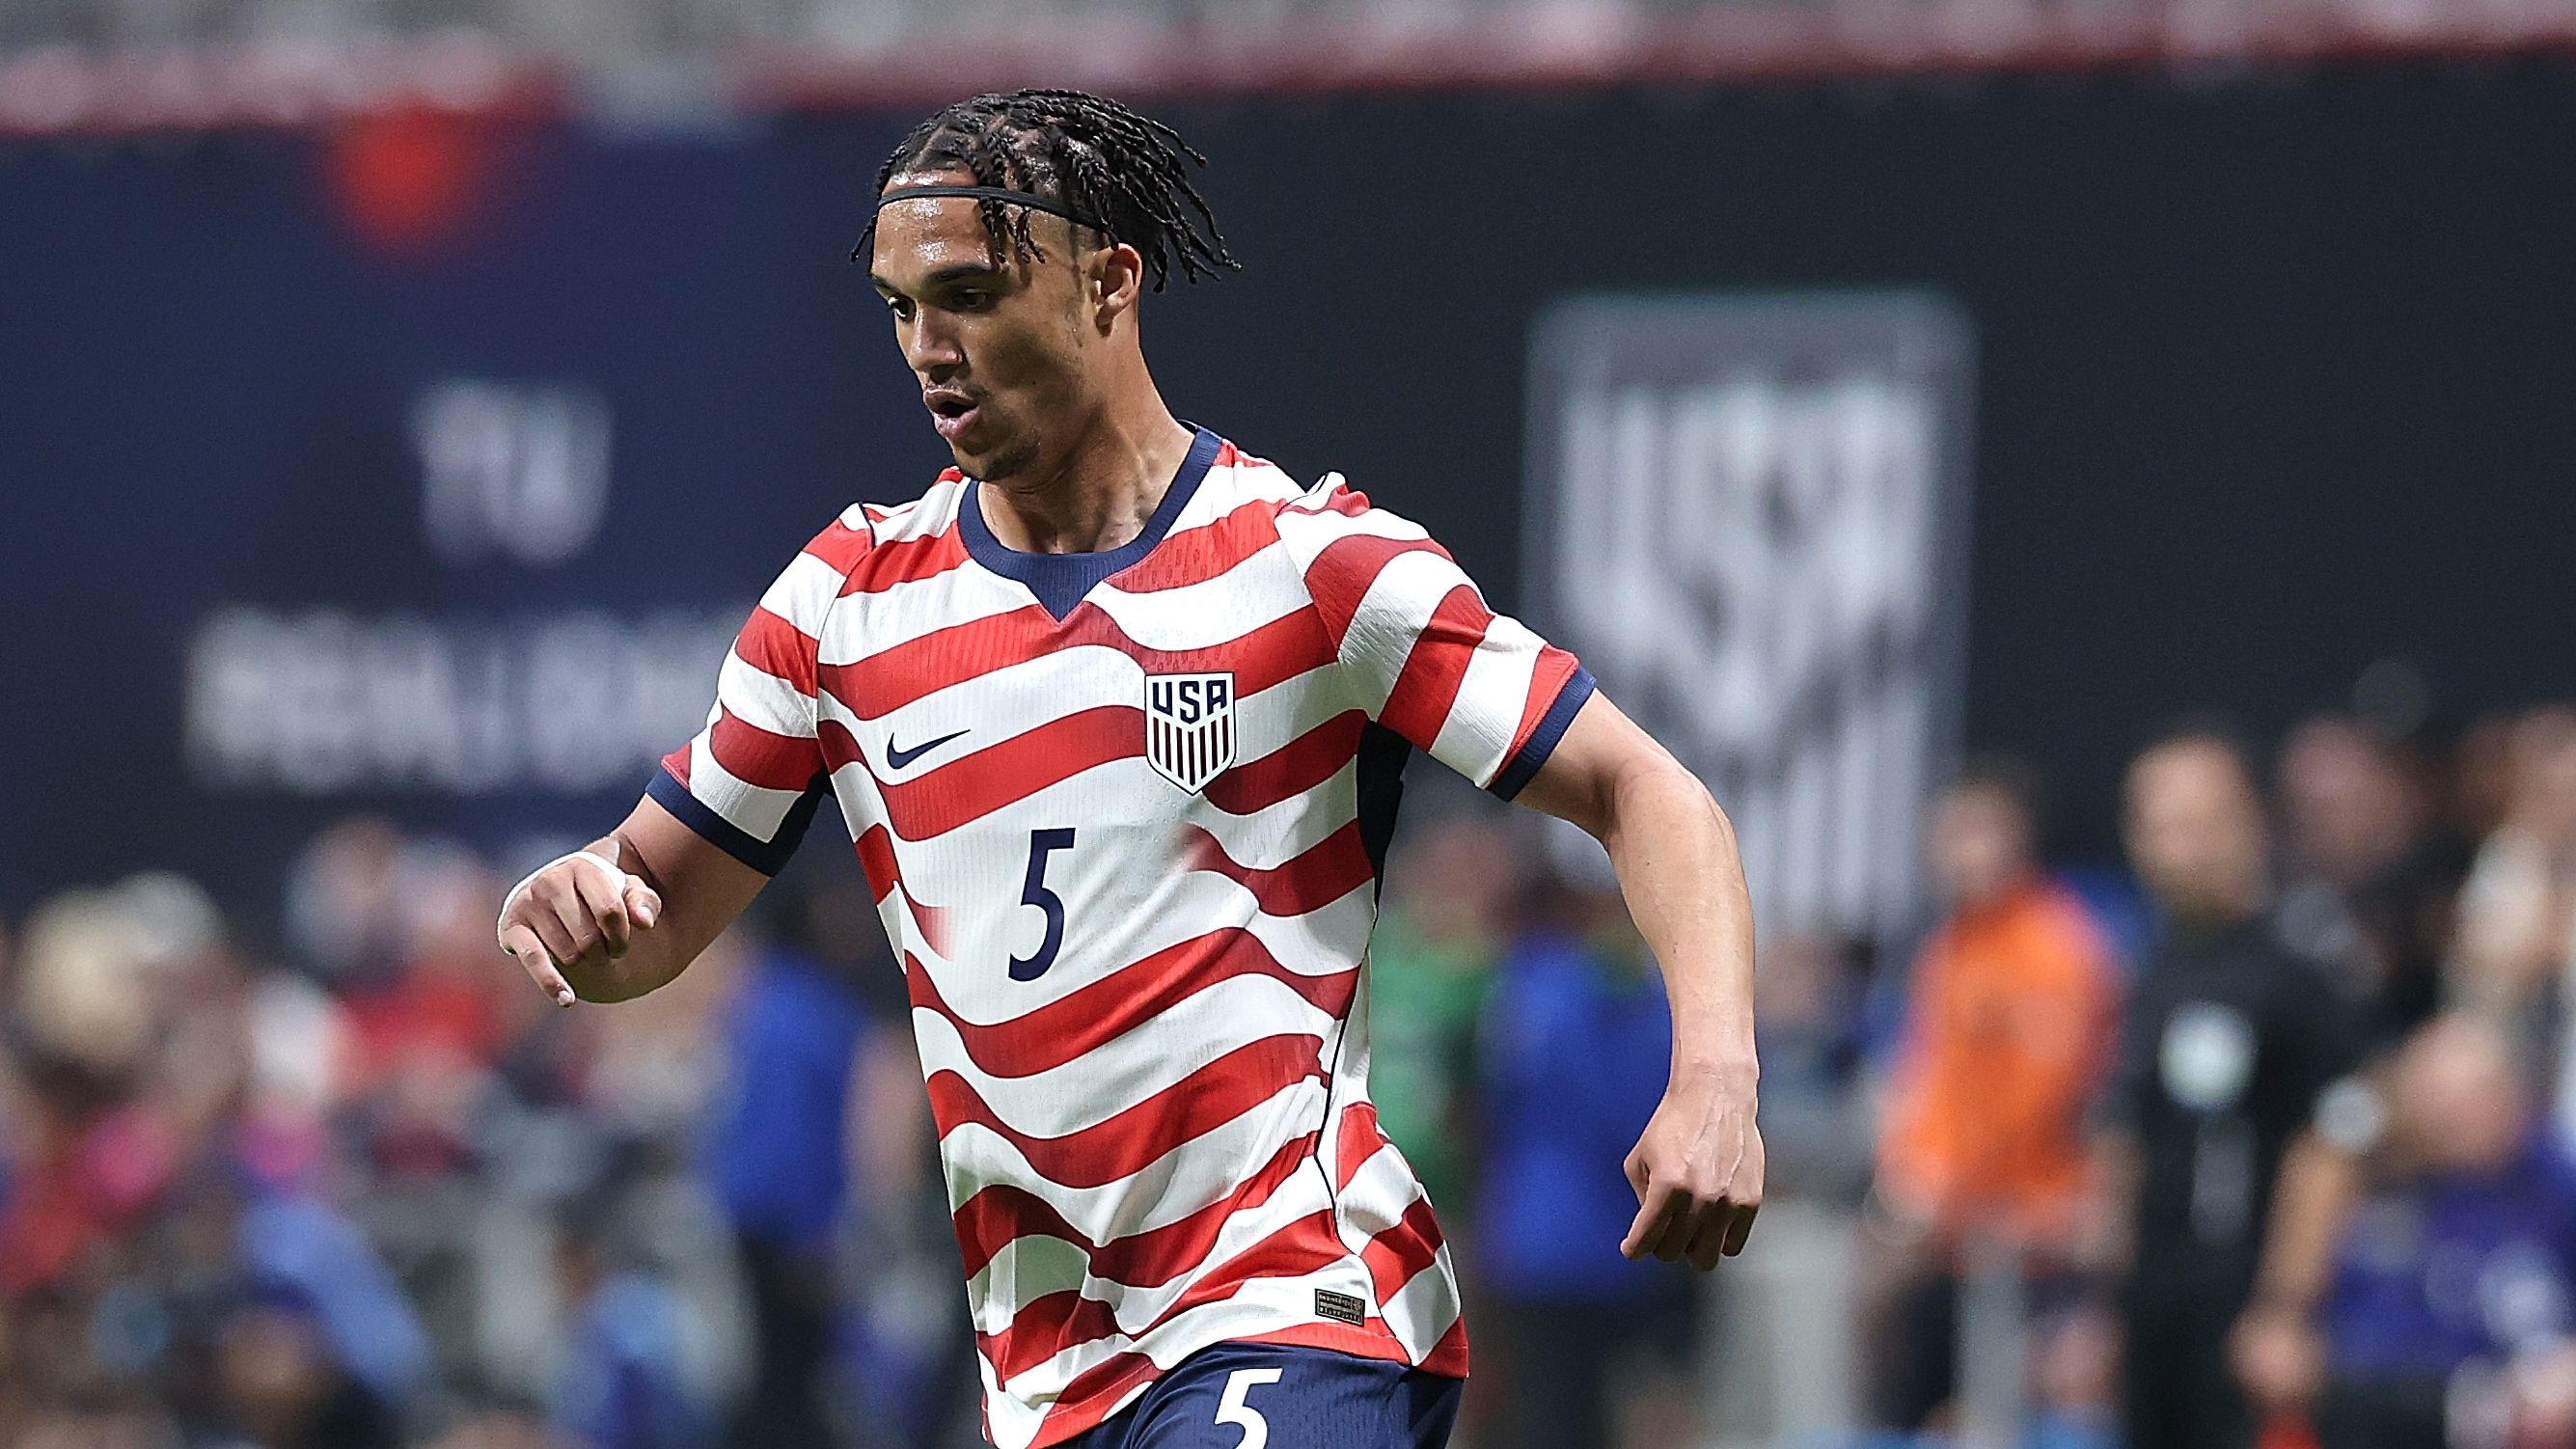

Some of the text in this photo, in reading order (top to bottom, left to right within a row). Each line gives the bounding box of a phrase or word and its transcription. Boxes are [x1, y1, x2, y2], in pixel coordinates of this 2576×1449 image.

[1152, 679, 1227, 724] USA
[1007, 827, 1076, 982] 5
[1214, 1367, 1283, 1449] 5
